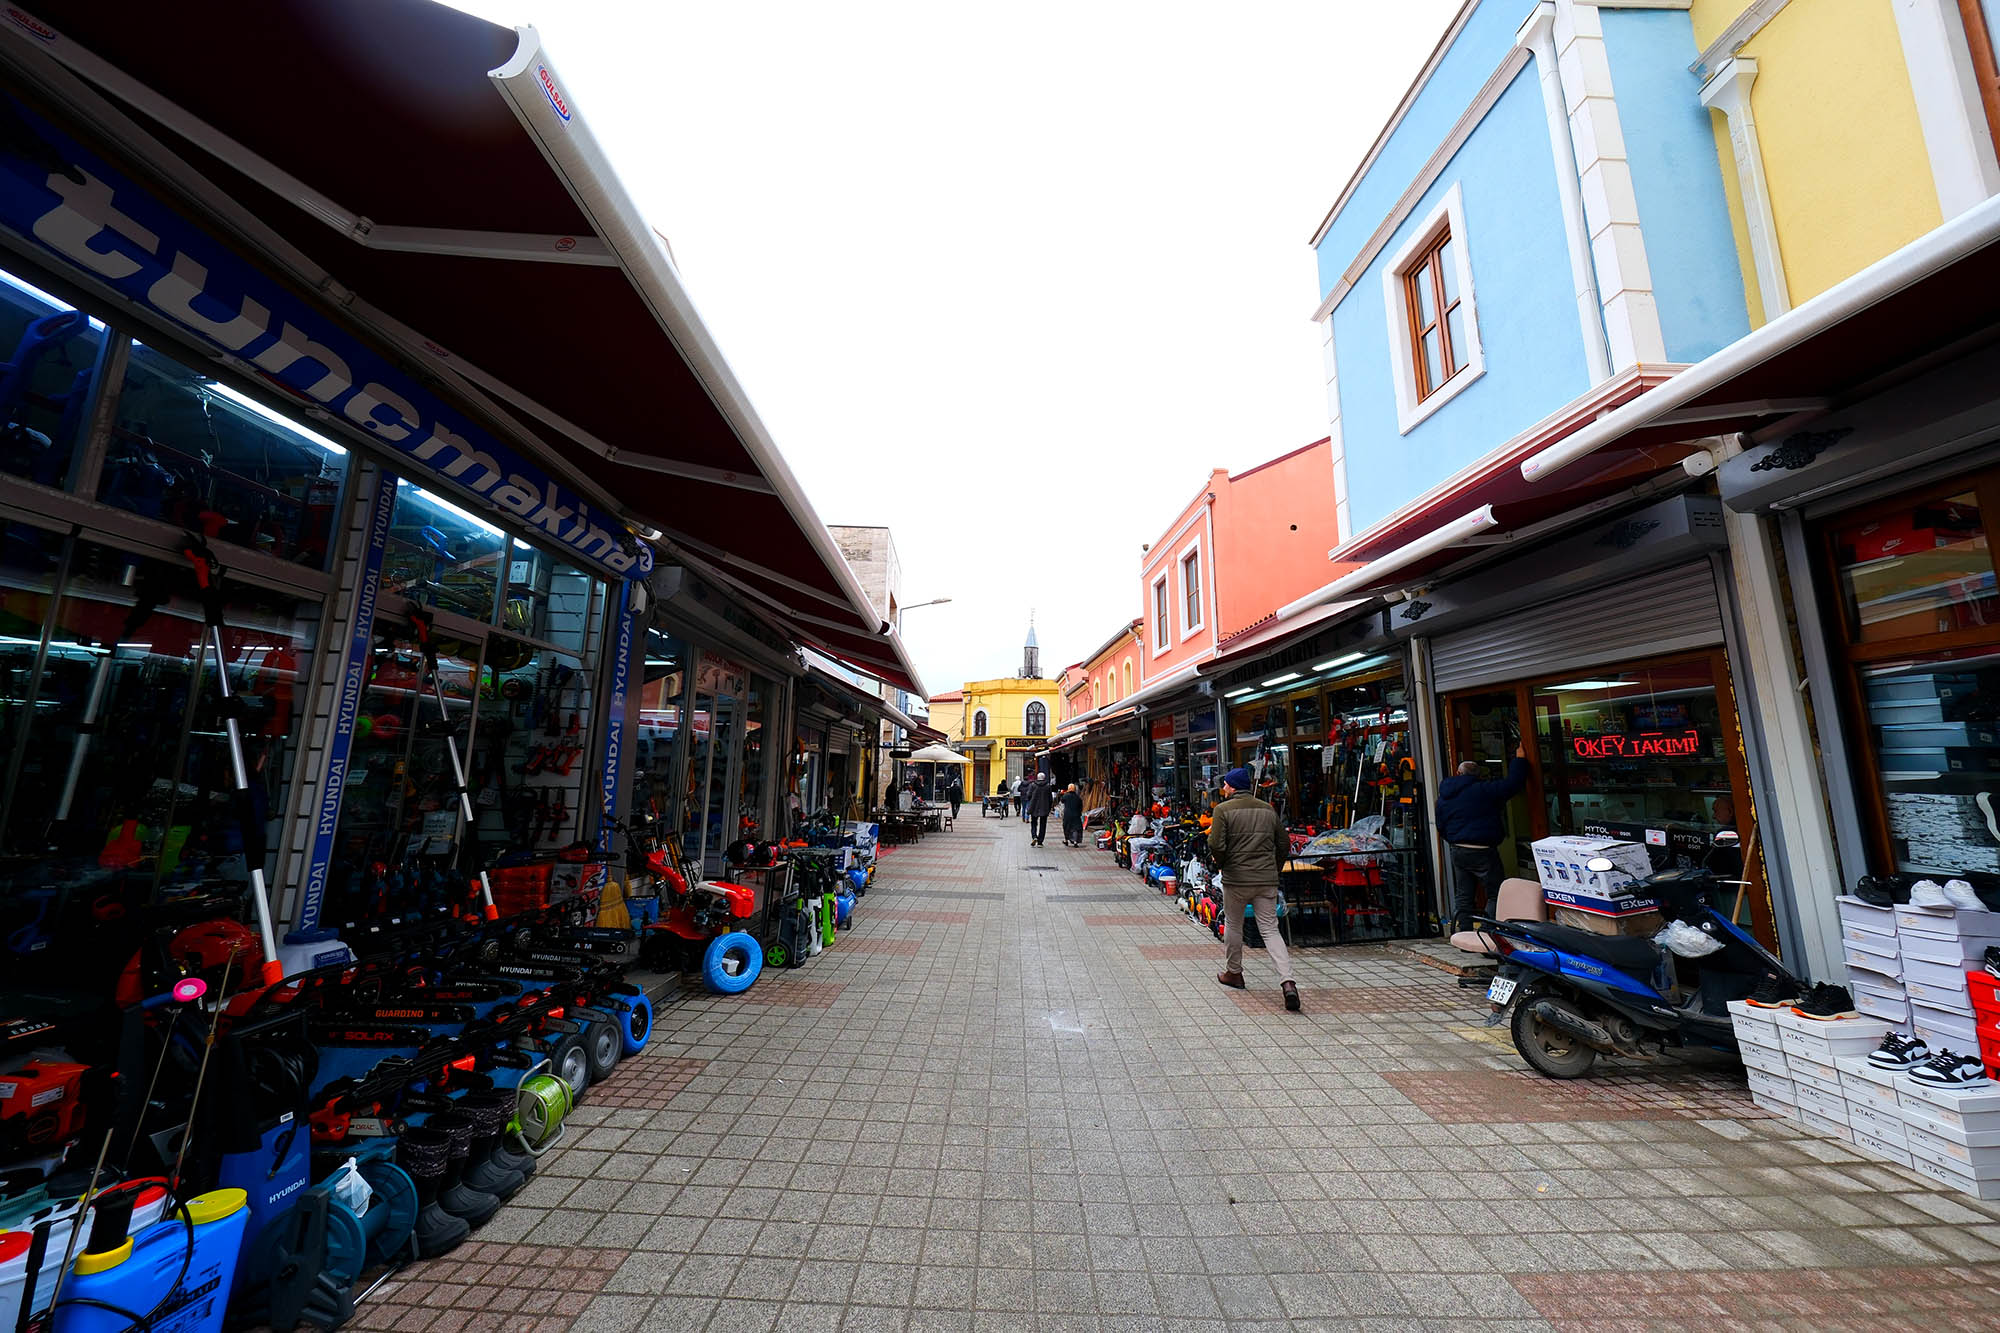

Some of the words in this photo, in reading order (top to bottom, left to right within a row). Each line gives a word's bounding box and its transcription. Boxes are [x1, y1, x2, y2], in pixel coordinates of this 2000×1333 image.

[371, 479, 394, 549] HYUNDAI
[356, 567, 379, 639] HYUNDAI
[613, 611, 632, 706] HYUNDAI
[338, 661, 362, 735] HYUNDAI
[1576, 738, 1625, 757] OKEY
[319, 758, 344, 835] HYUNDAI
[1584, 825, 1609, 835] MYTOL
[1673, 834, 1705, 845] MYTOL
[302, 861, 326, 931] YUNDAI
[1547, 891, 1576, 904] EXEN
[1620, 898, 1654, 910] EXEN
[531, 953, 560, 962] HYUNDAI
[499, 966, 532, 976] HYUNDAI
[375, 1009, 424, 1018] GUARDINO
[344, 1031, 394, 1041] SOLAX
[269, 1177, 306, 1204] HYUNDAI
